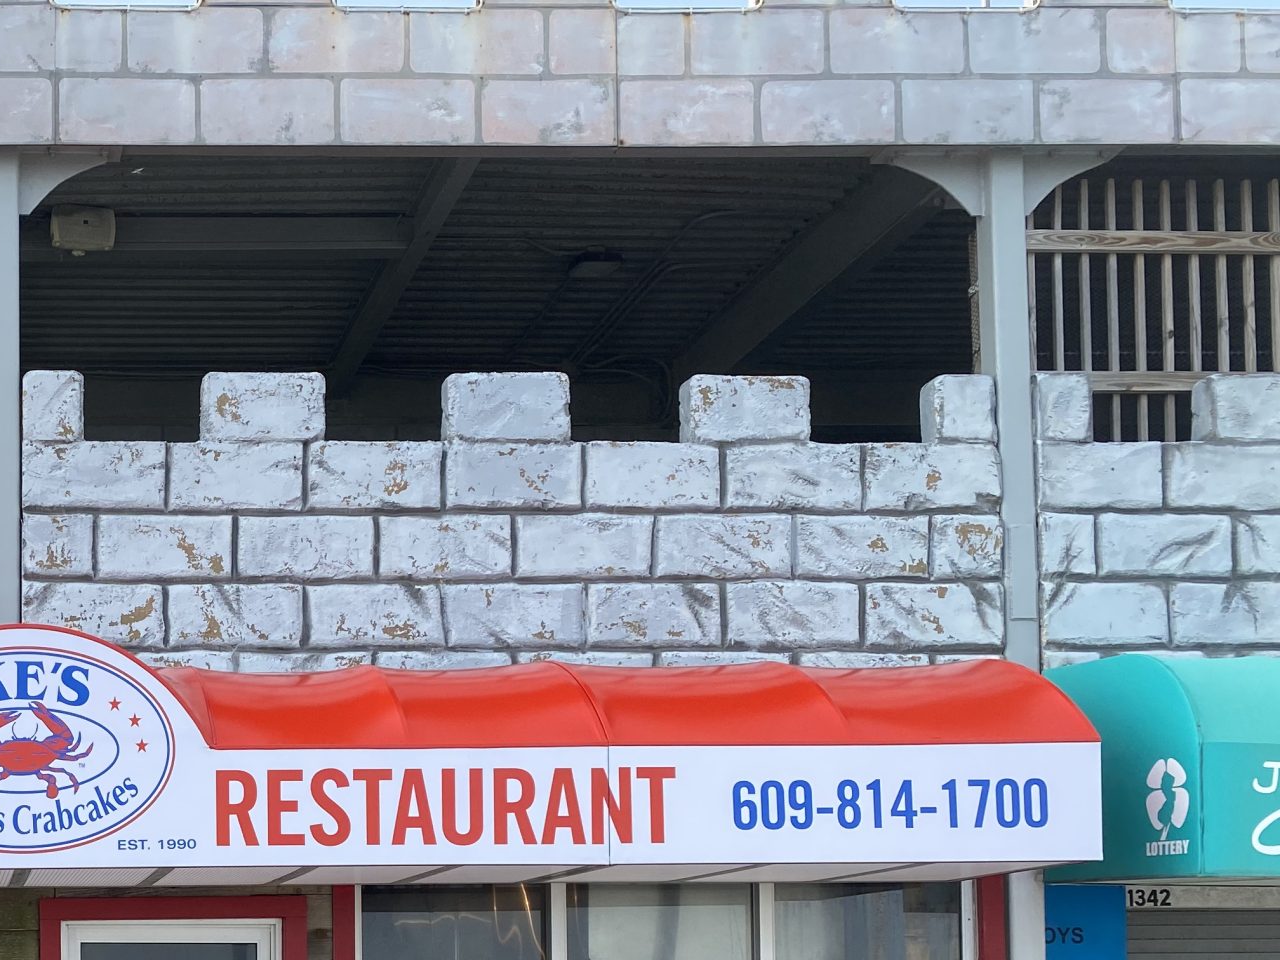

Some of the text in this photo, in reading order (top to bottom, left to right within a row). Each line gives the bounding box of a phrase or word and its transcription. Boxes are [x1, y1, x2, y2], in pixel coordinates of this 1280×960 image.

[12, 775, 139, 835] Crabcakes
[215, 766, 676, 847] RESTAURANT
[732, 777, 1049, 830] 609-814-1700
[117, 838, 197, 851] EST. 1990
[1146, 839, 1190, 857] LOTTERY
[1127, 888, 1171, 907] 1342
